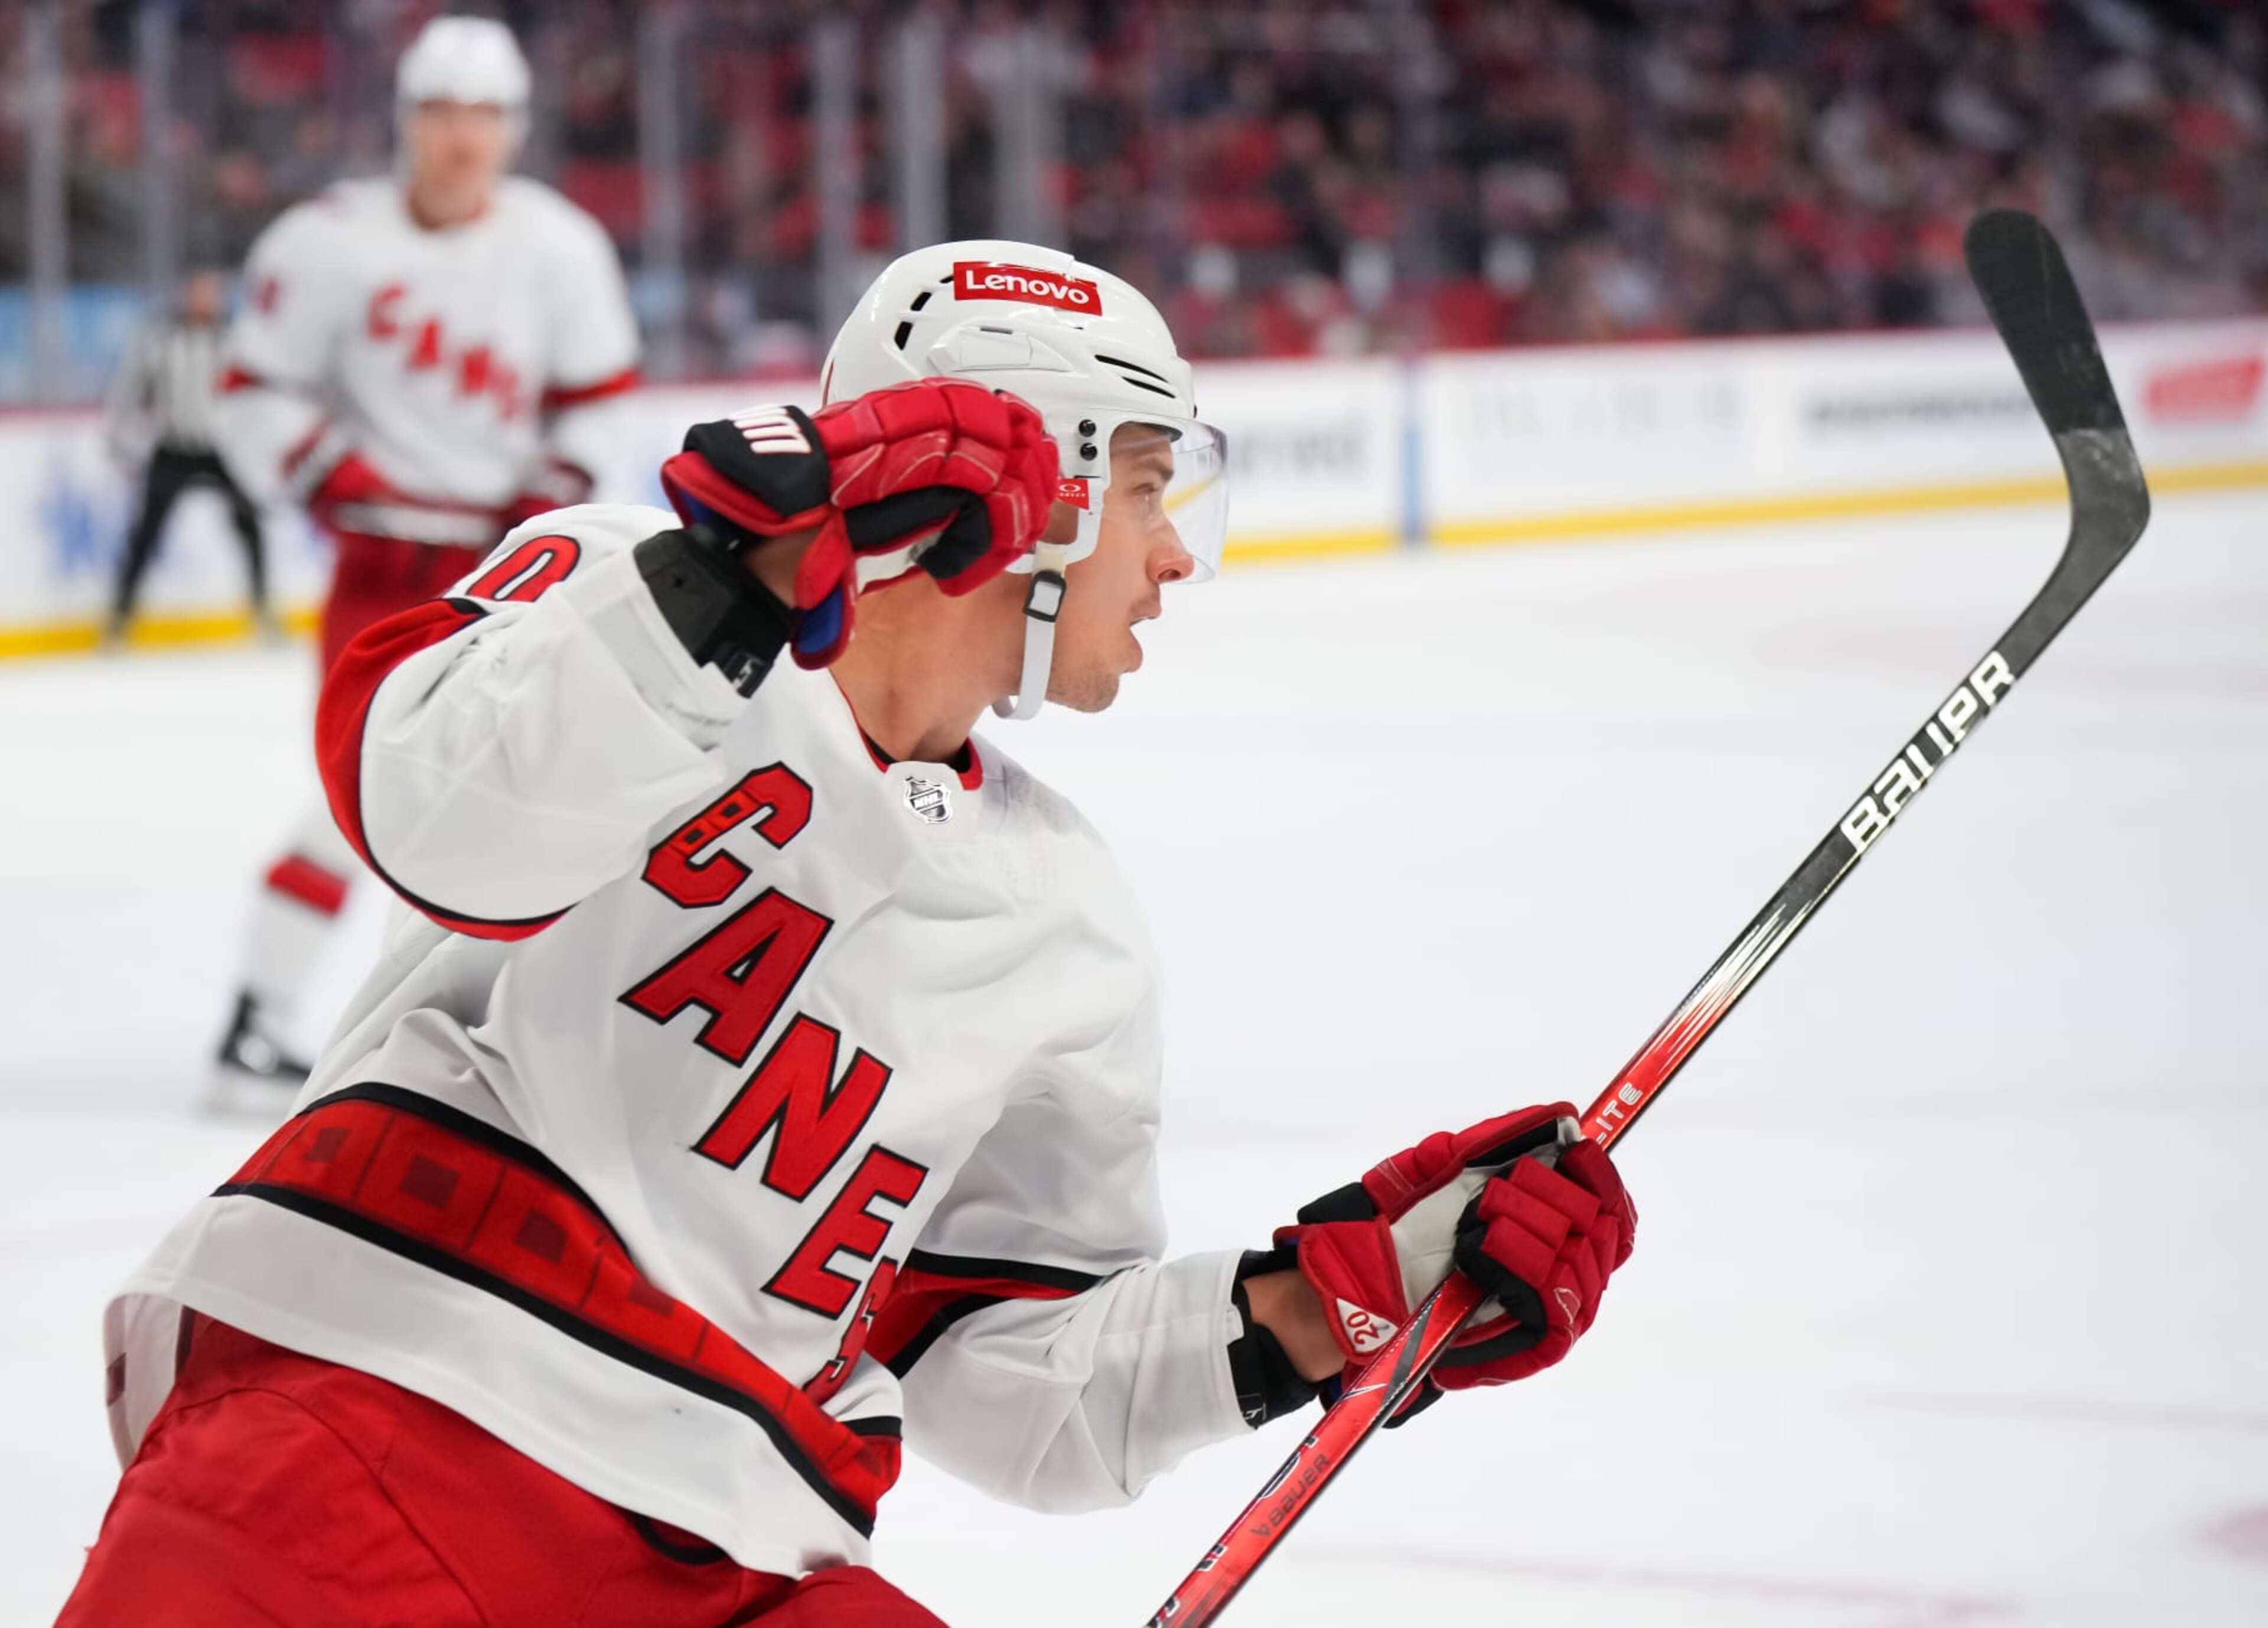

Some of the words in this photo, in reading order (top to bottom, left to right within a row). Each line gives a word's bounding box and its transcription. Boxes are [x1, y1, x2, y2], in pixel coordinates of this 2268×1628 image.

[966, 269, 1090, 304] Lenovo
[914, 791, 943, 808] NHL
[617, 760, 930, 1406] CANES
[1347, 1311, 1380, 1345] 20
